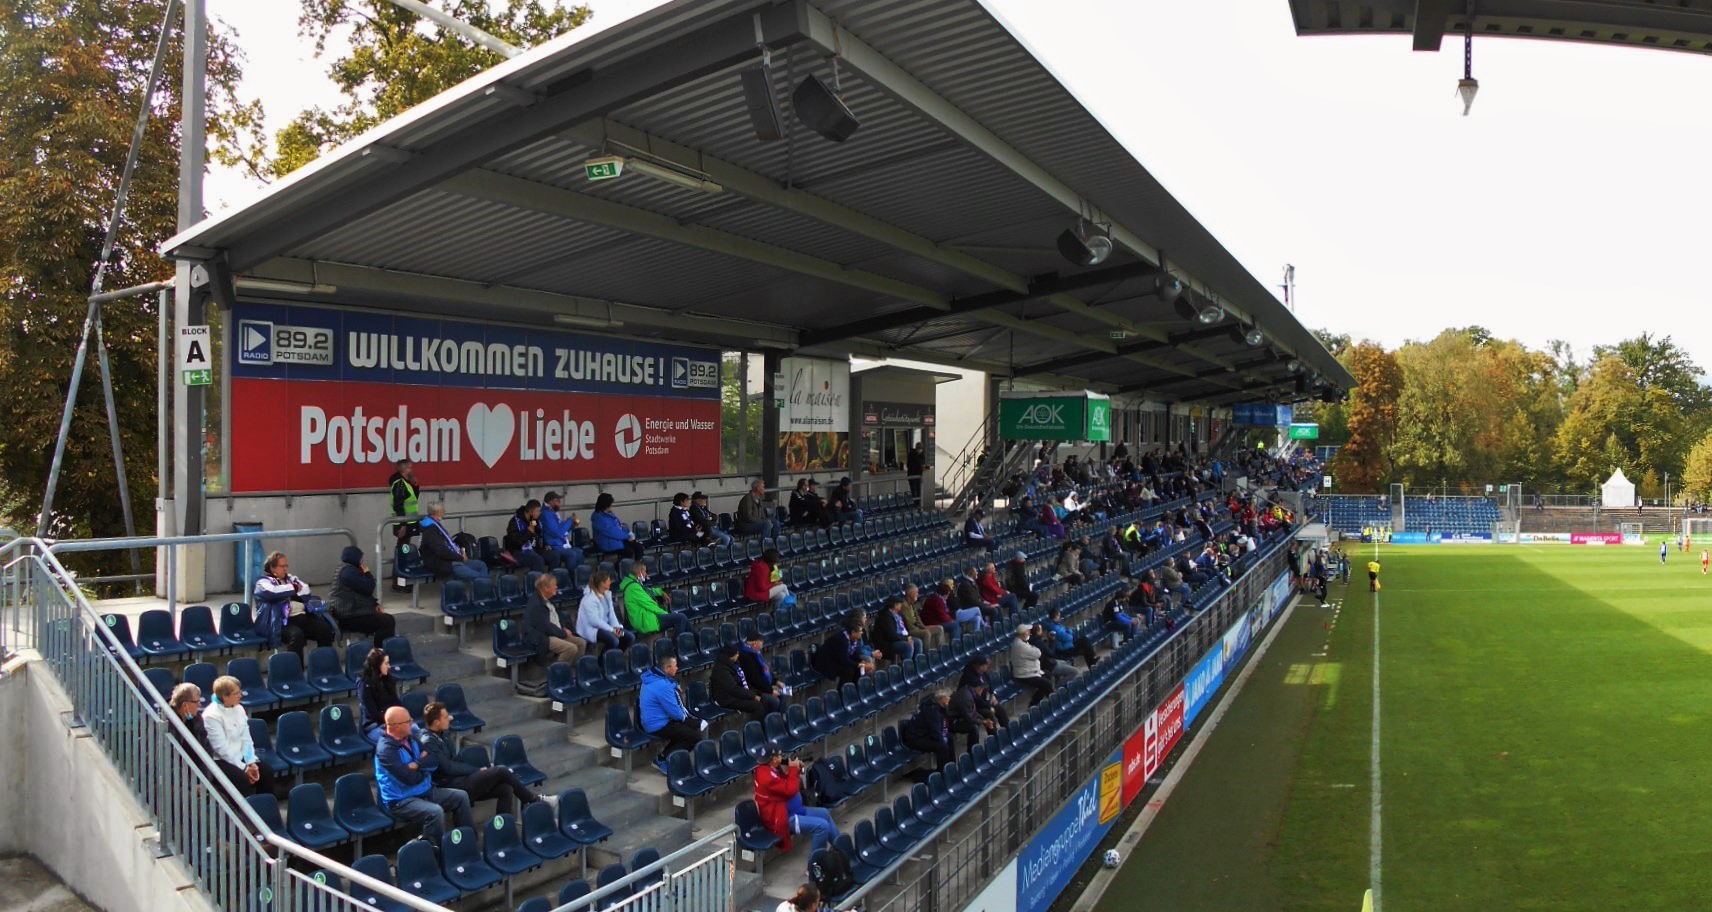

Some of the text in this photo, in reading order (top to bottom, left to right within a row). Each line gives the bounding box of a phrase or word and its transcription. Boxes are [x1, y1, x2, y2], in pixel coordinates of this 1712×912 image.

[276, 330, 329, 350] 89.2
[186, 340, 206, 363] A
[243, 351, 269, 360] RADIO
[276, 351, 329, 362] POTSDAM
[349, 331, 544, 378] WILLKOMMEN
[689, 363, 717, 378] 89.2
[1018, 404, 1065, 424] AOK
[1091, 406, 1106, 425] AOK
[645, 417, 715, 432] Energie und Wasser
[300, 404, 596, 465] Potsdam Liebe
[645, 433, 676, 444] Stadtwerke
[645, 445, 670, 455] Potsdam
